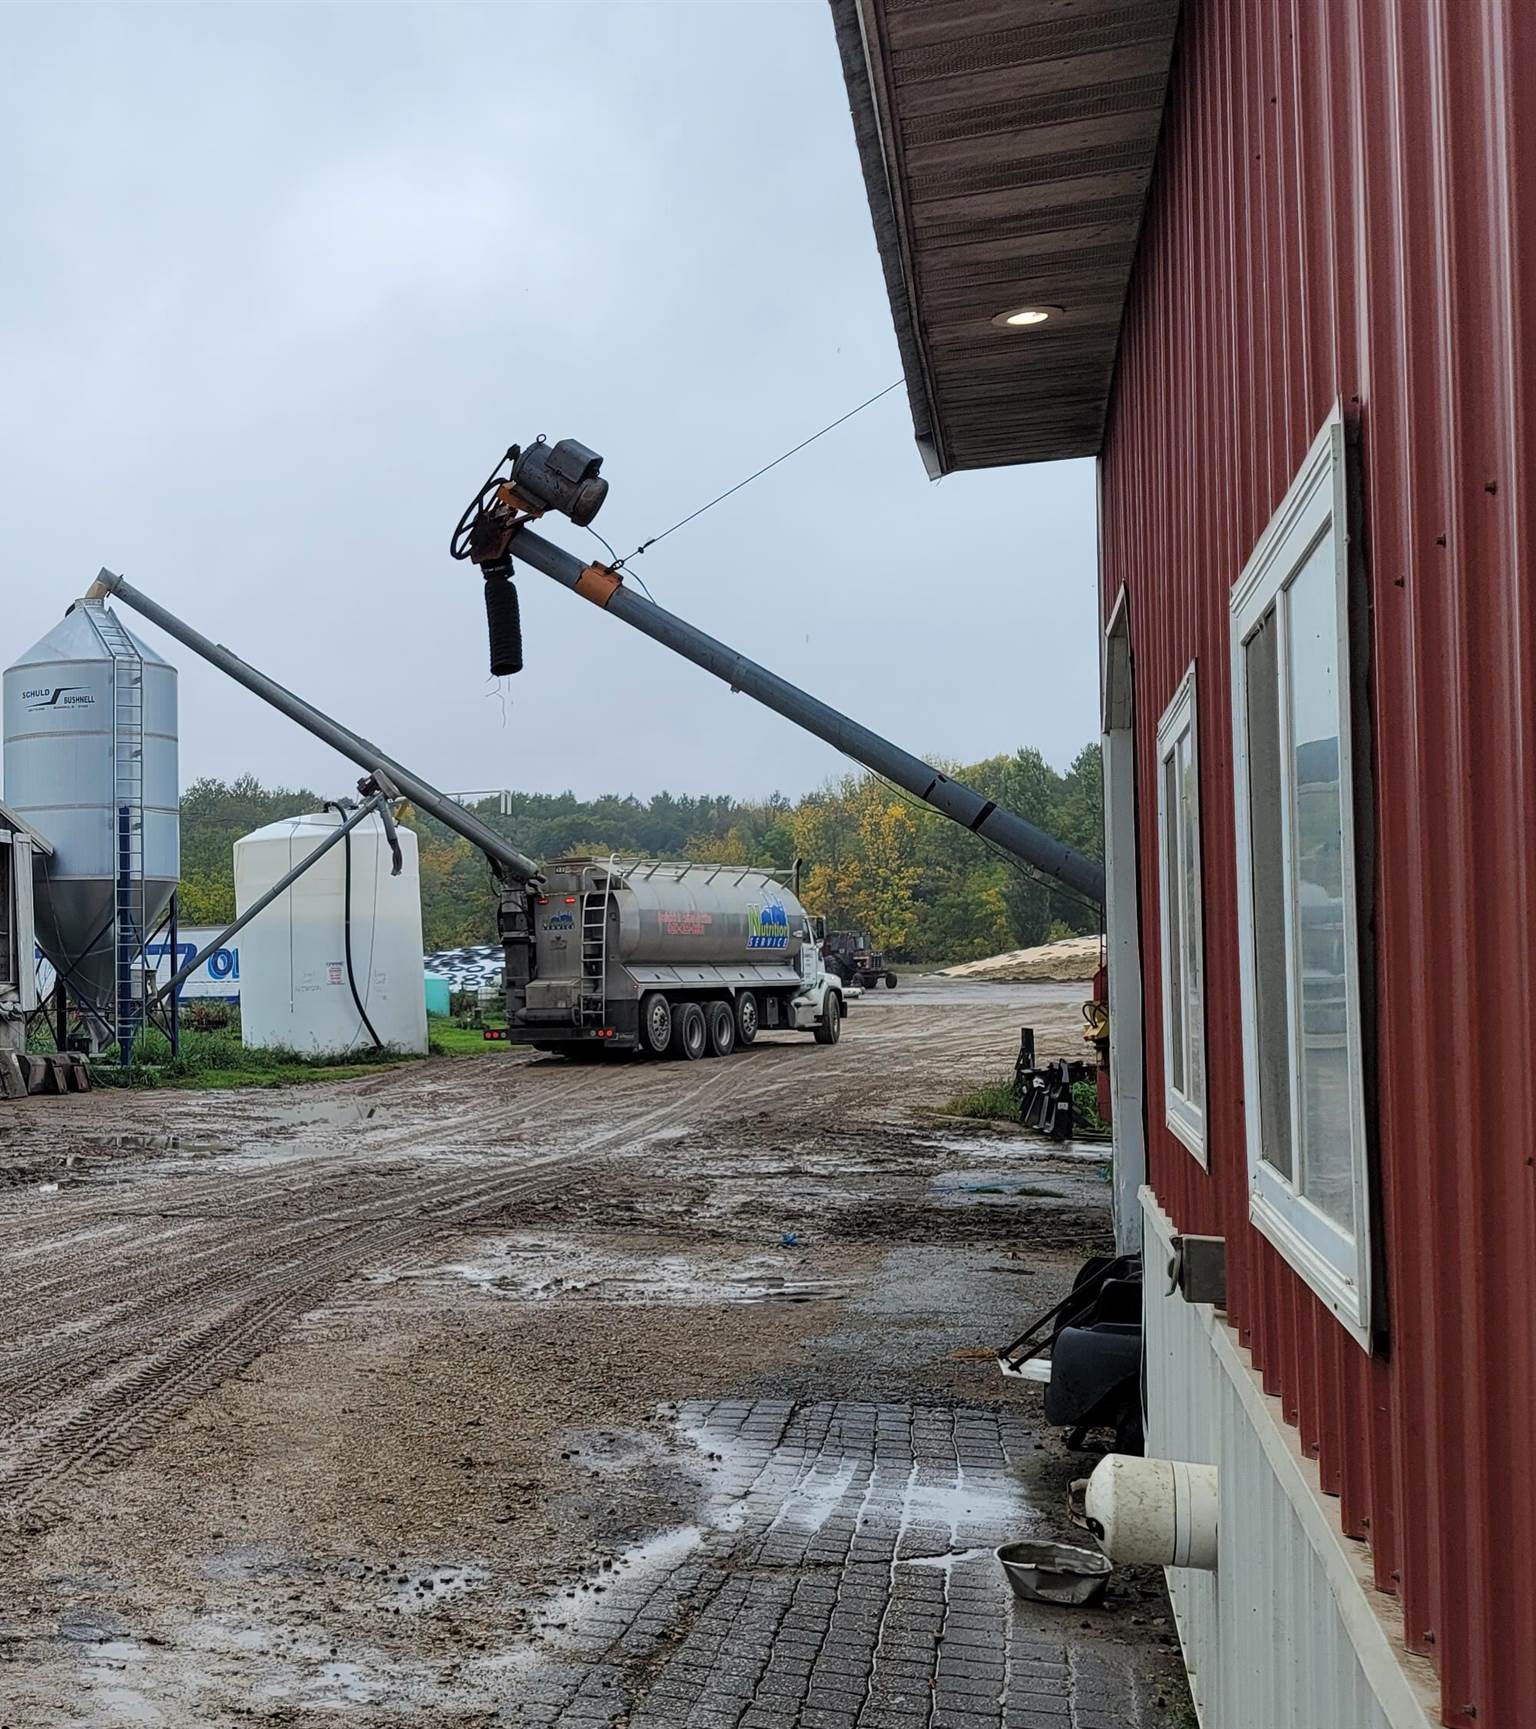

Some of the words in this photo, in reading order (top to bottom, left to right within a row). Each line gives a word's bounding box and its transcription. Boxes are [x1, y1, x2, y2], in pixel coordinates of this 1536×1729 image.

[22, 688, 50, 699] SCHULD
[64, 695, 96, 705] BUSHNELL
[747, 903, 789, 938] Nutrition
[747, 936, 788, 948] SERVICE
